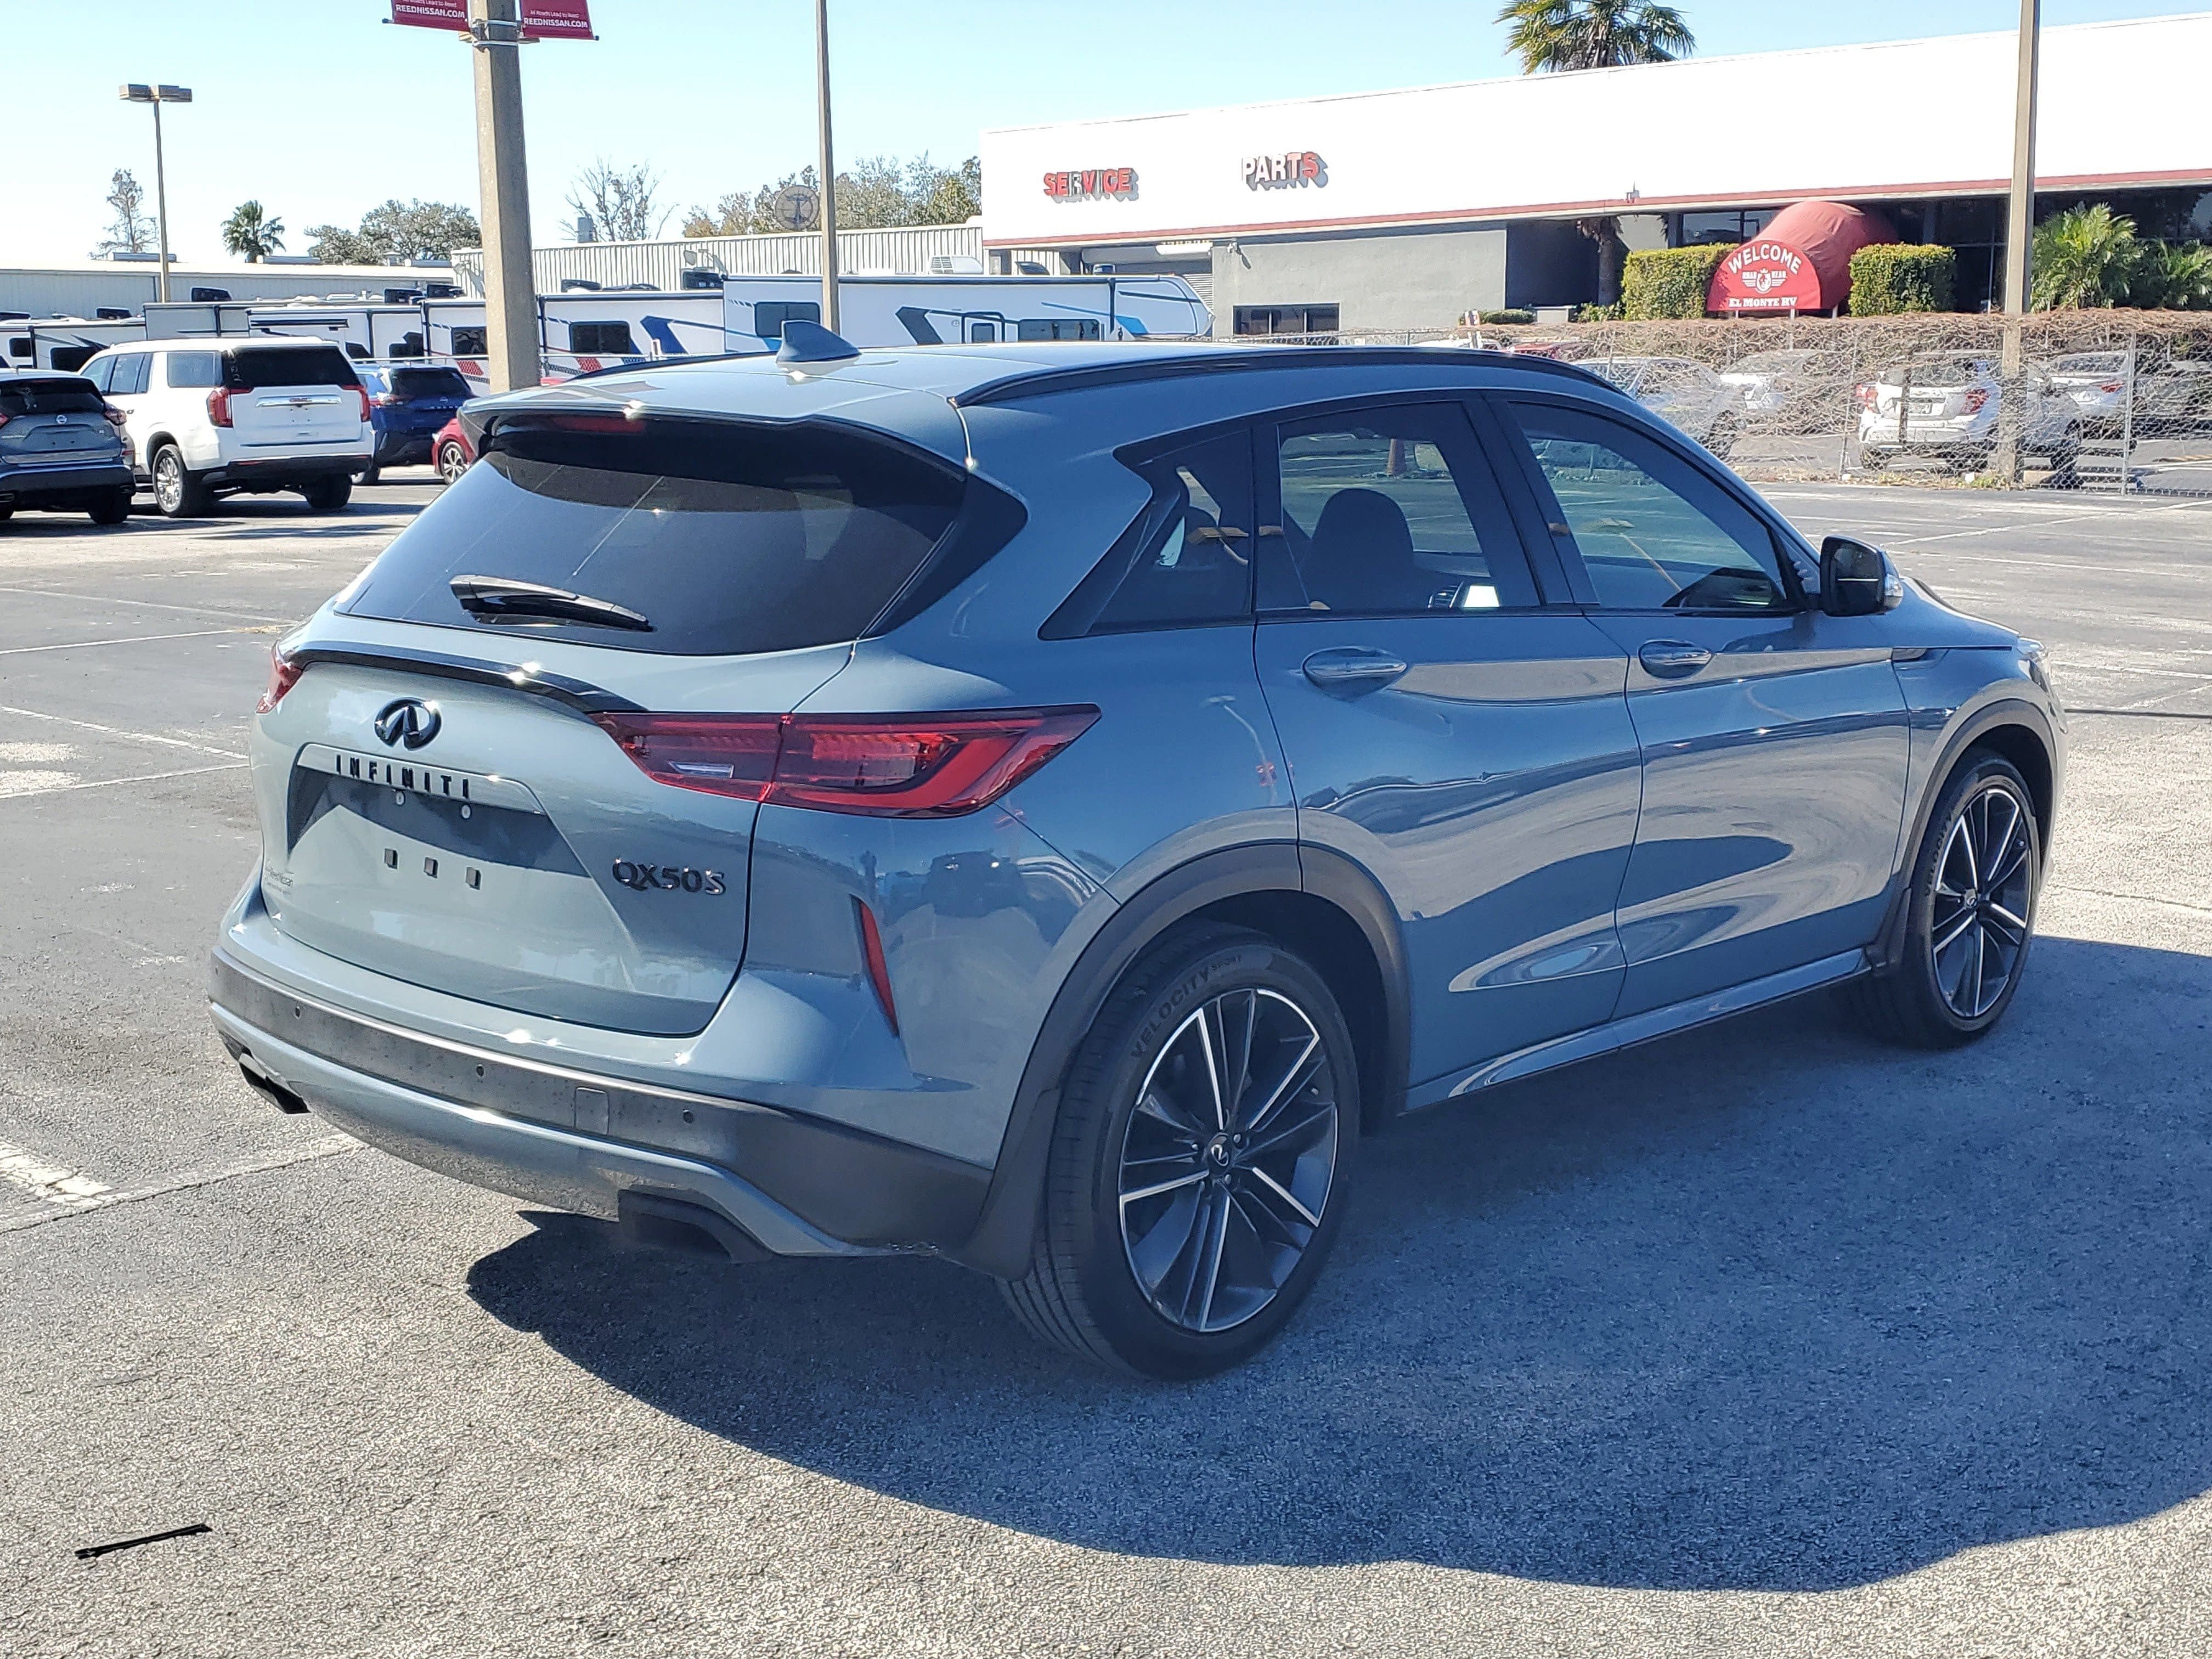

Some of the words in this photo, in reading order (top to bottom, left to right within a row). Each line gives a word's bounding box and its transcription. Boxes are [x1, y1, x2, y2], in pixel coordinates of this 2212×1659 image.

[396, 4, 465, 18] REEDNISSAN.COM
[523, 18, 588, 28] REEDNISSAN.COM
[1043, 167, 1135, 198] SERVICE
[1242, 151, 1321, 184] PARTS
[1728, 244, 1802, 274] WELCOME
[1729, 298, 1742, 307] EL
[1743, 297, 1780, 307] MONTE
[336, 754, 469, 799] INFINITI
[1130, 966, 1209, 1059] VELOCITY
